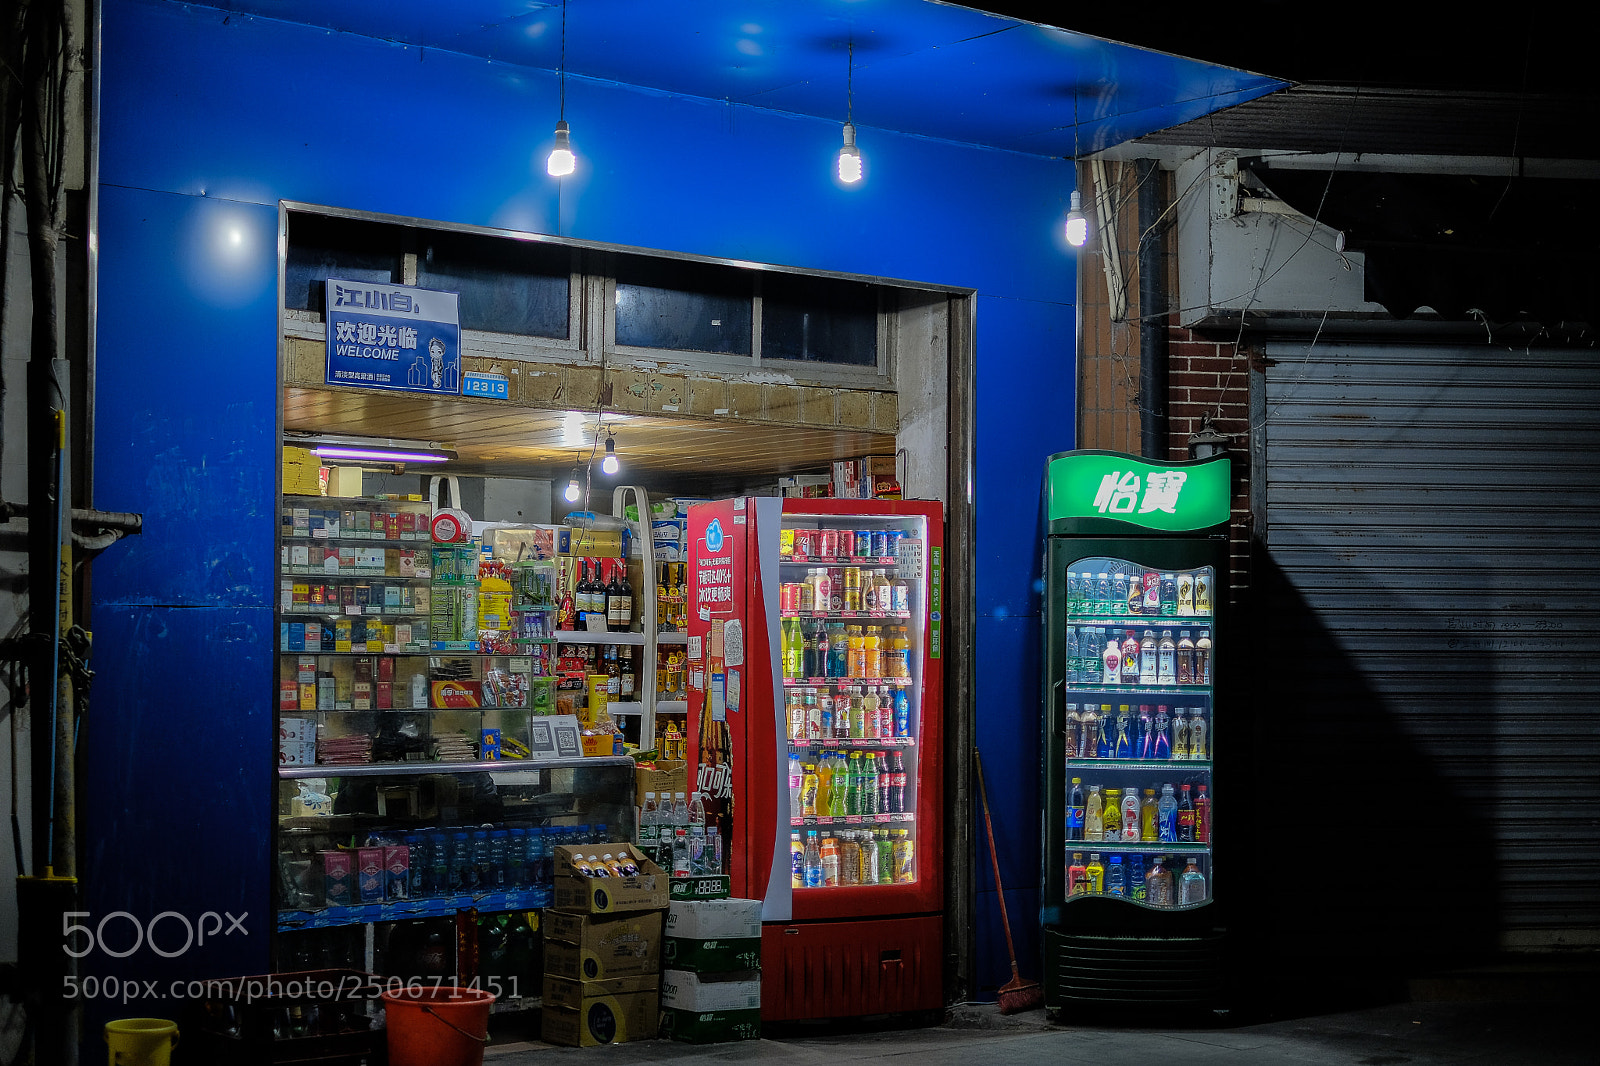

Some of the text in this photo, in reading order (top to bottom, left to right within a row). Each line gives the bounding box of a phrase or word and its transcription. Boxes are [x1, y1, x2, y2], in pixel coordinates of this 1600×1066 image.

[335, 285, 412, 313] 江小白
[336, 321, 418, 349] 欢迎光临
[336, 345, 399, 361] WELCOME
[467, 380, 504, 393] 12313
[1093, 471, 1187, 513] 怡寶
